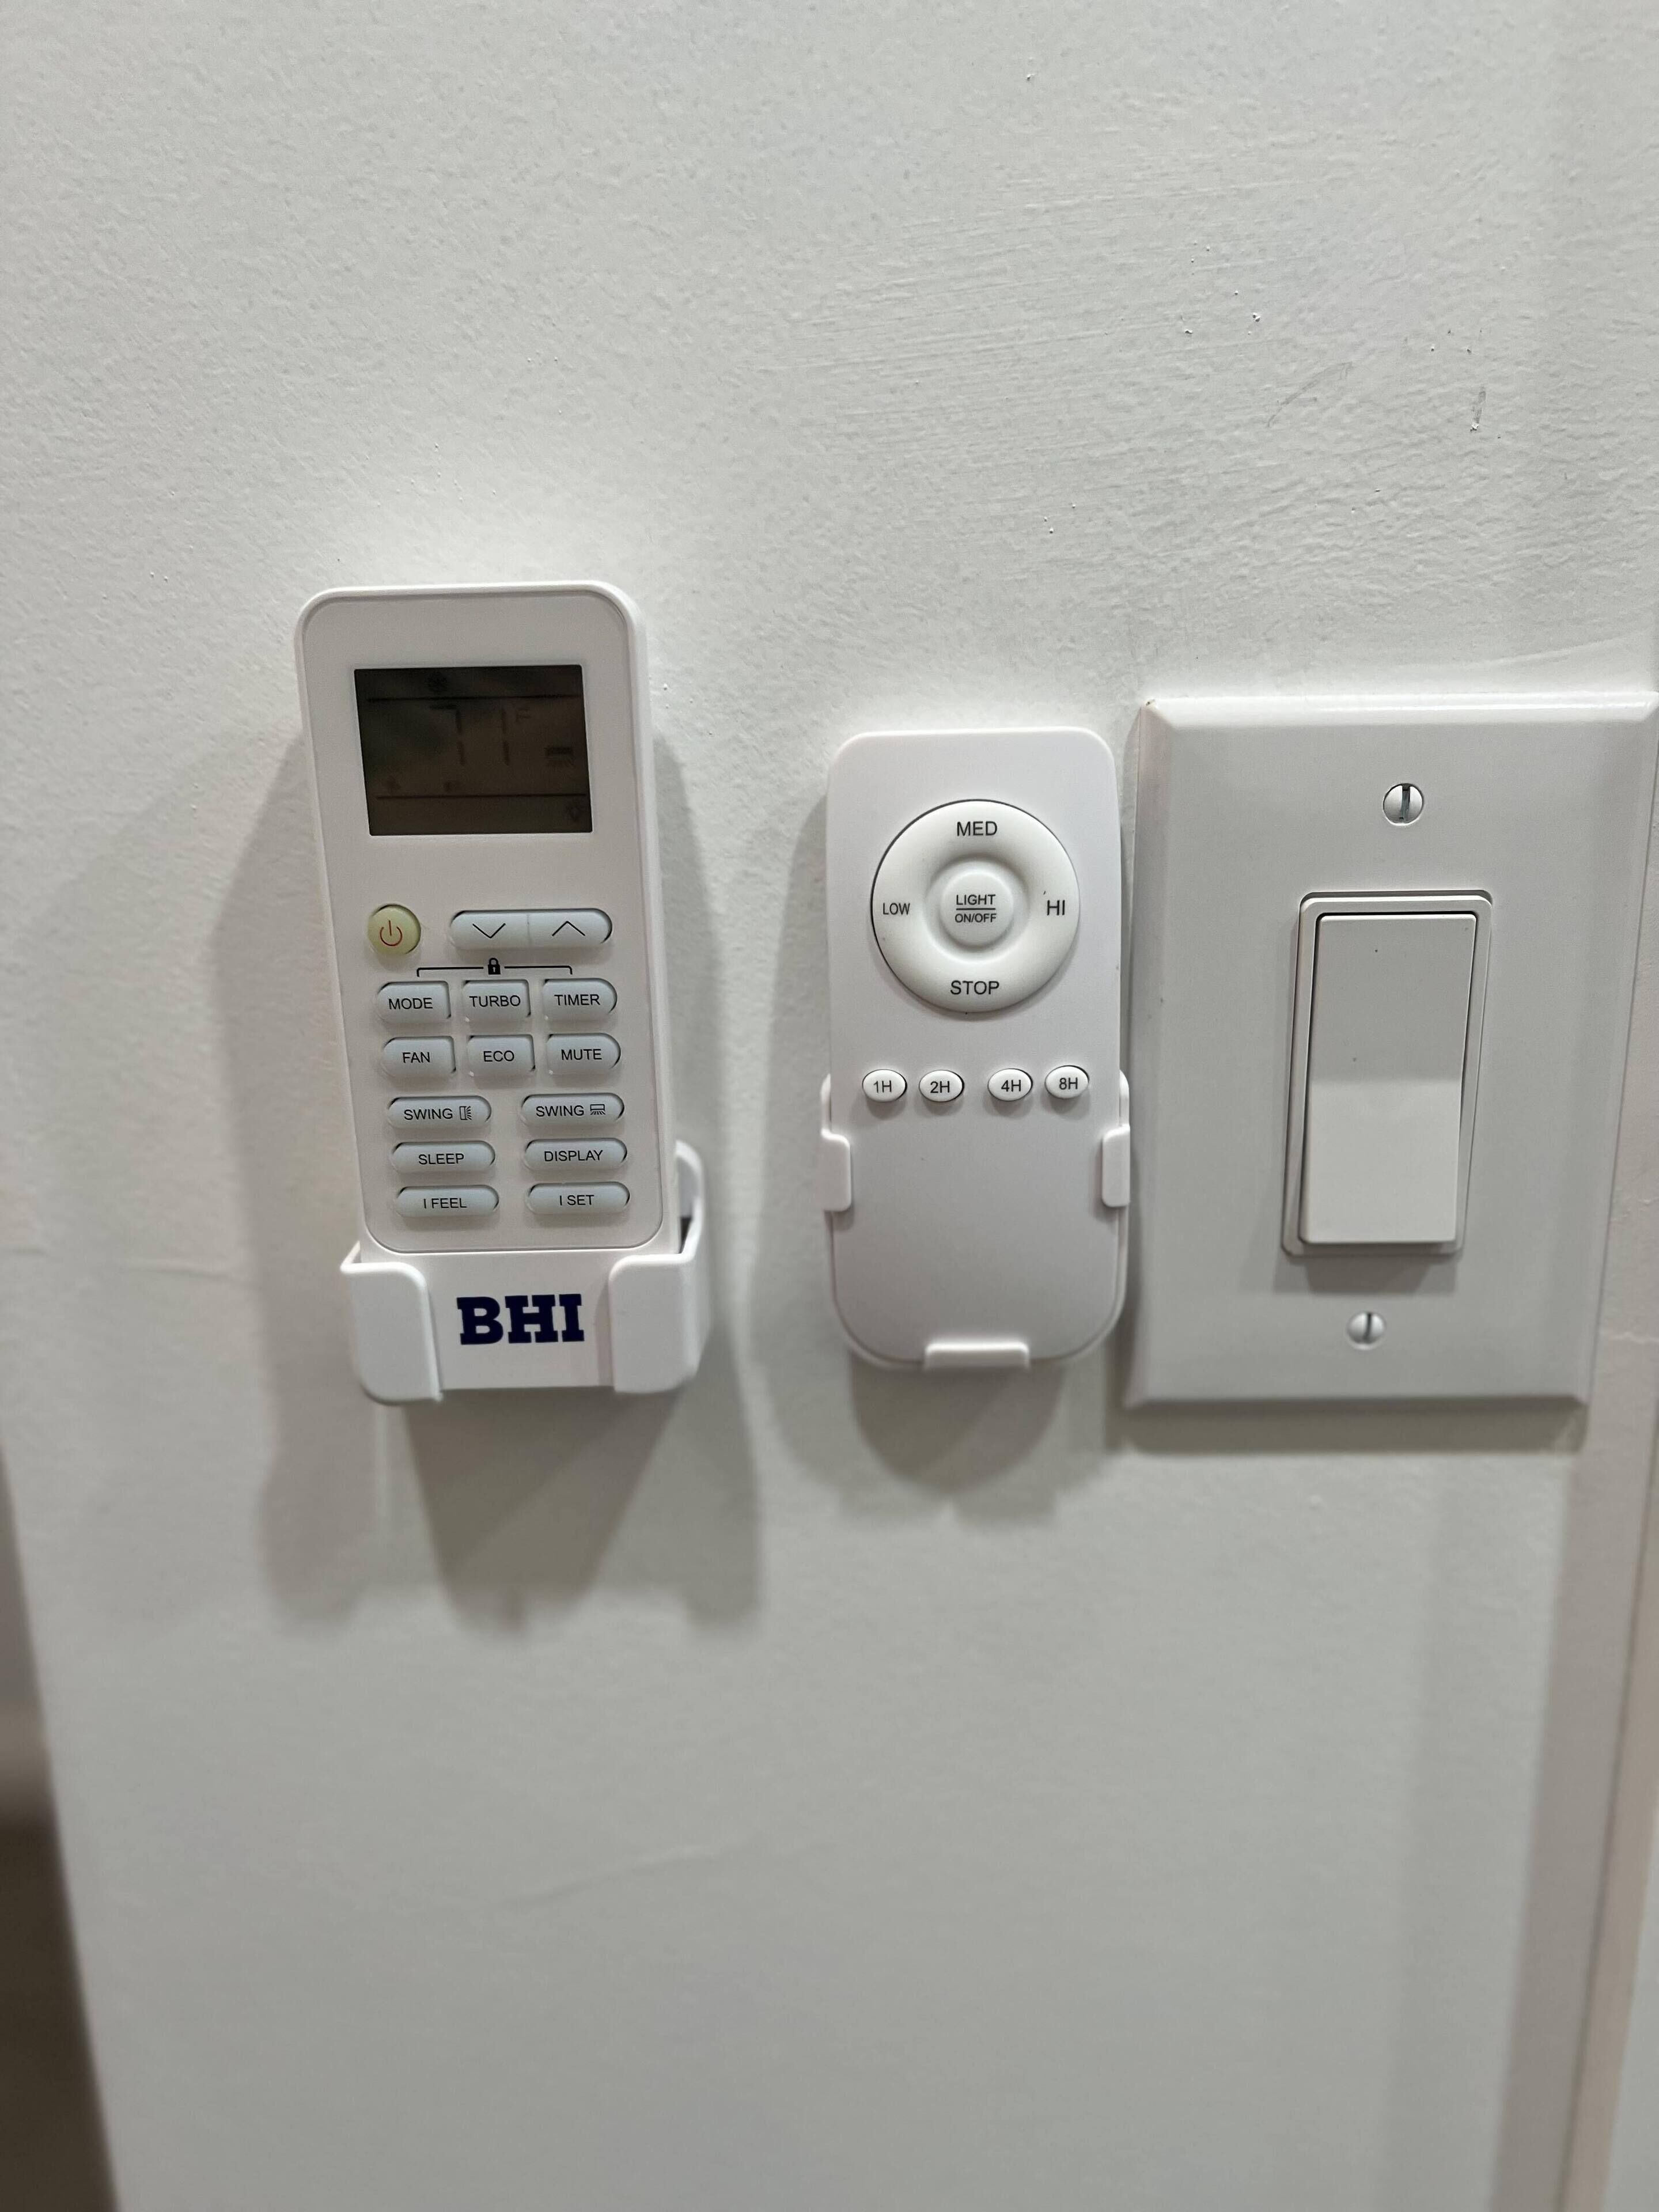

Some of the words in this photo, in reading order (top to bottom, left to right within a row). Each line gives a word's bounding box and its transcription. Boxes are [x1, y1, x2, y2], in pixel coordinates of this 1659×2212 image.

[956, 821, 998, 837] MED
[956, 894, 996, 906] LIGHT
[882, 902, 911, 915] LOW
[1047, 900, 1065, 916] HI
[955, 912, 997, 923] ON/OFF
[950, 980, 1000, 996] STOP
[388, 997, 433, 1010] MODE
[469, 995, 521, 1007] TURBO
[554, 994, 601, 1006] TIMER
[402, 1051, 430, 1063] FAN
[483, 1050, 515, 1062] ECO
[561, 1048, 603, 1060] MUTE
[872, 1081, 892, 1093] 1H
[929, 1081, 951, 1094] 2H
[1000, 1080, 1022, 1093] 4H
[1058, 1077, 1079, 1091] 8H
[404, 1108, 453, 1120] SWING
[536, 1105, 585, 1118] SWING
[418, 1153, 464, 1165] SLEEP
[544, 1150, 603, 1162] DISPLAY
[423, 1198, 427, 1209] I
[431, 1198, 467, 1209] FEEL
[559, 1195, 563, 1206] I
[567, 1194, 594, 1206] SET
[456, 1293, 585, 1345] BHI
